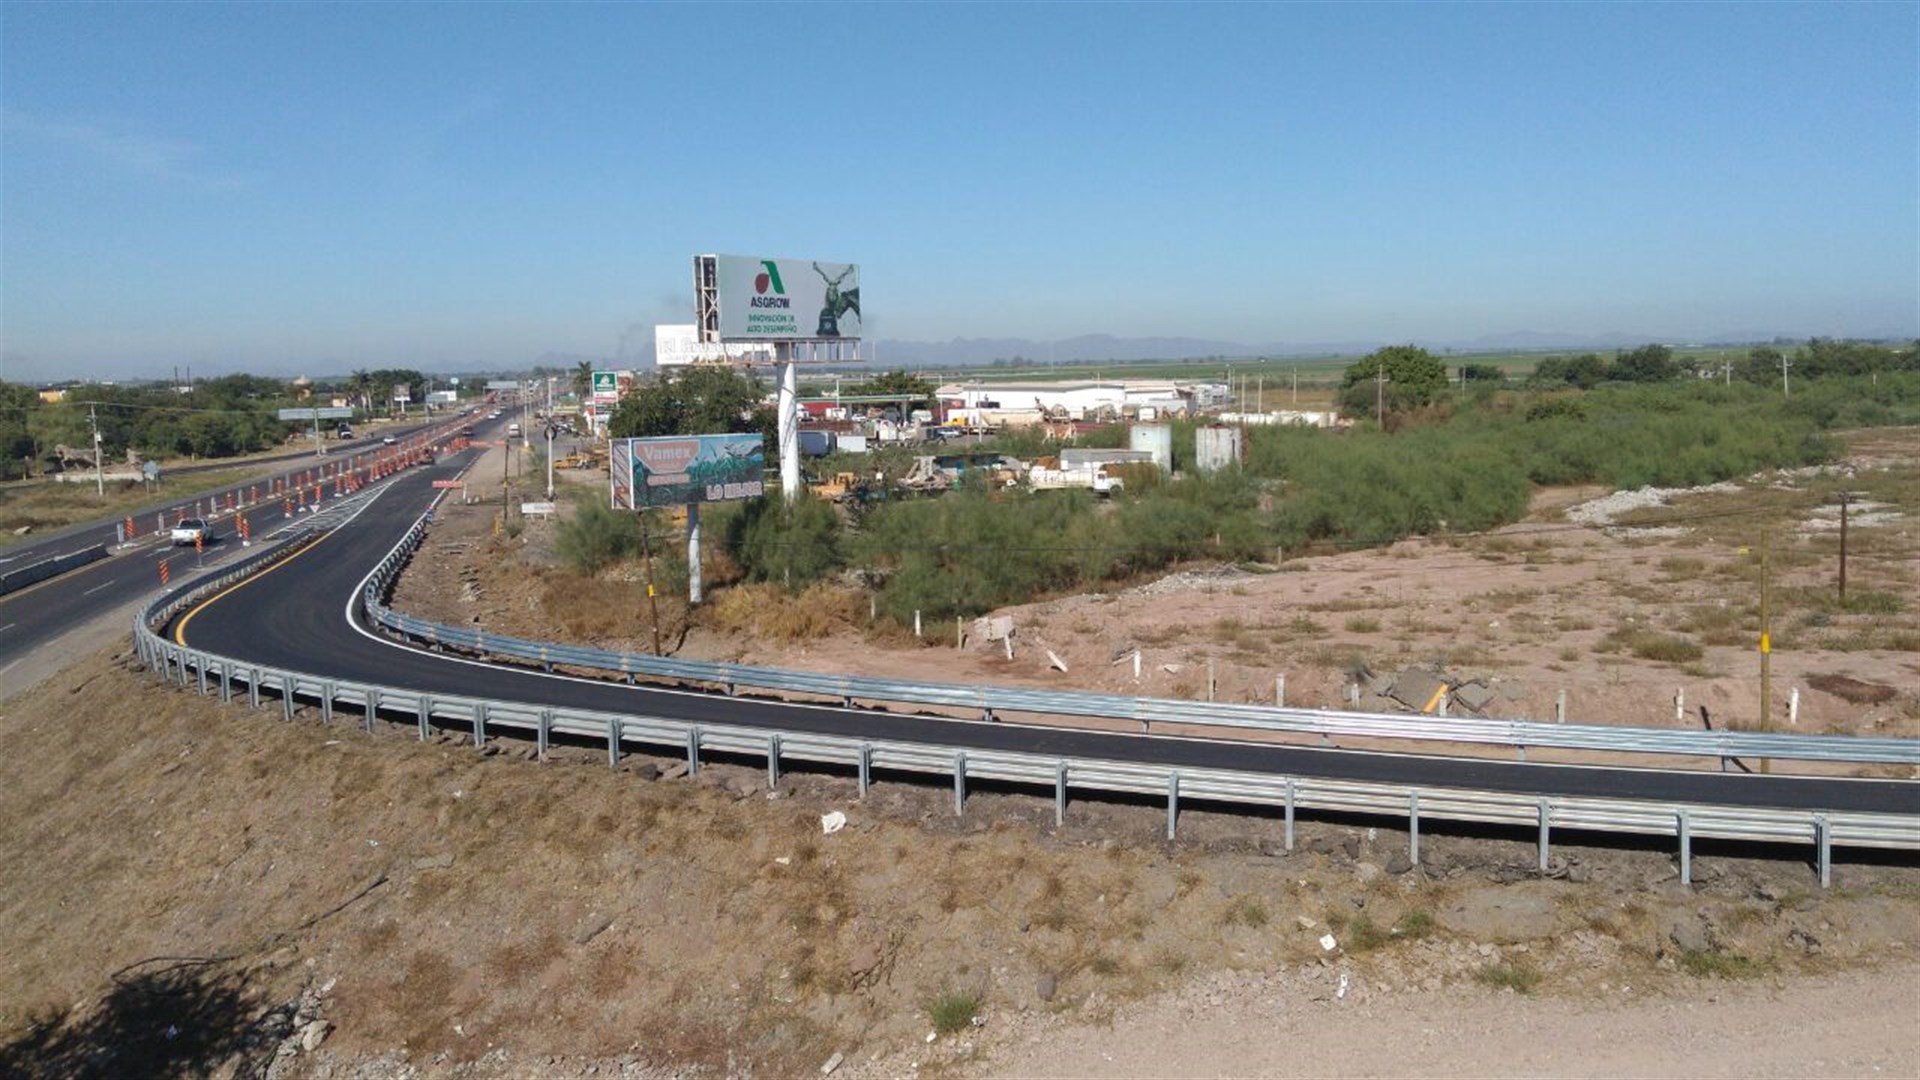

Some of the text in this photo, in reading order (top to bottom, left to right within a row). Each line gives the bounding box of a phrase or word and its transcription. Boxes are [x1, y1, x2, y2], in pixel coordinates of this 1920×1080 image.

[751, 296, 790, 308] ASGROW
[643, 446, 691, 460] Vamex
[707, 482, 763, 500] LO MEJOR
